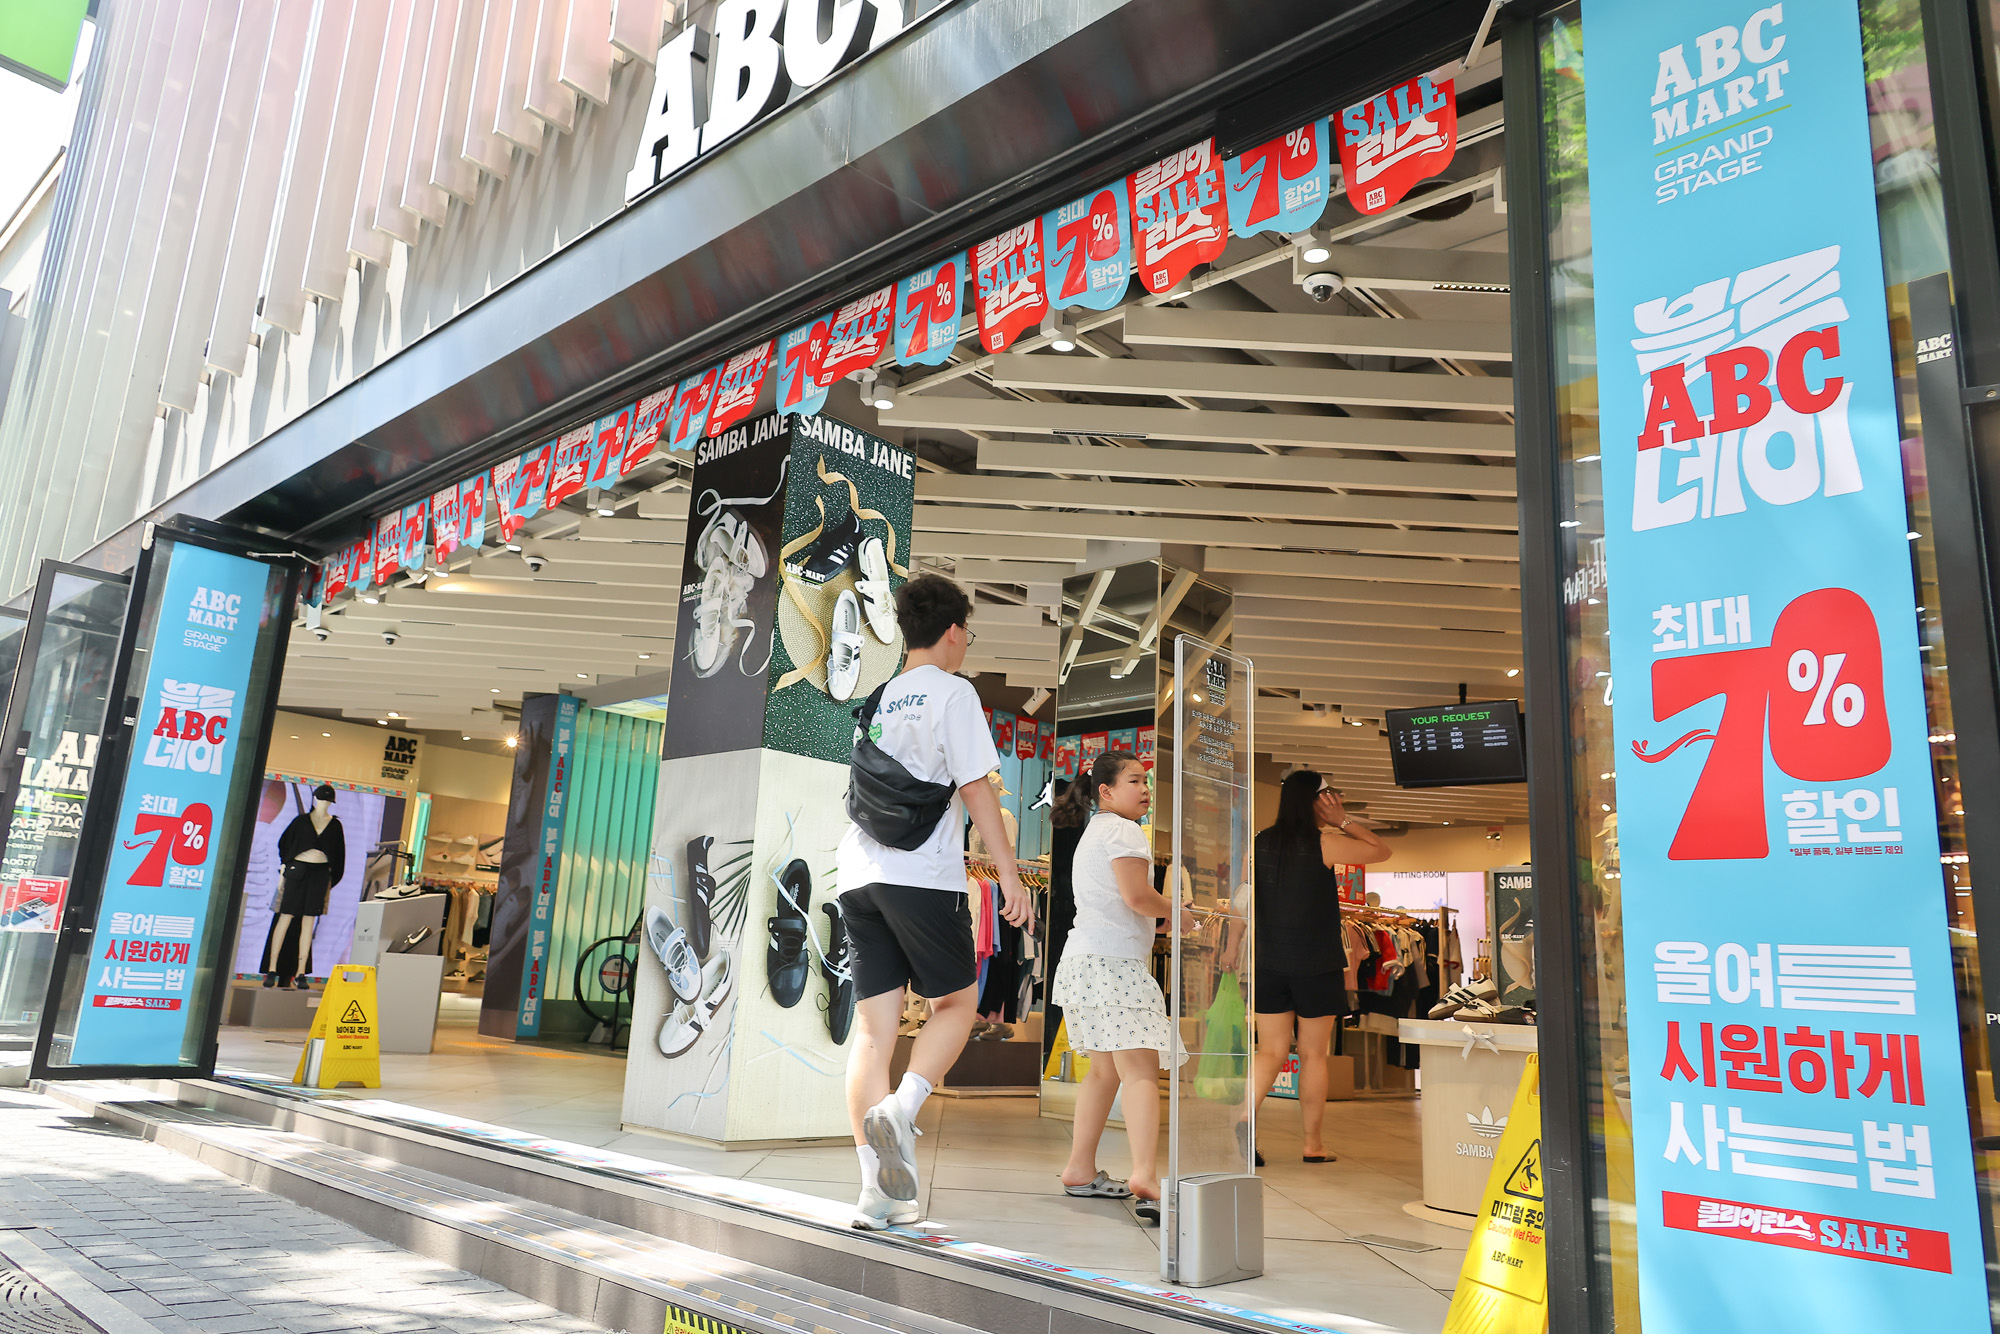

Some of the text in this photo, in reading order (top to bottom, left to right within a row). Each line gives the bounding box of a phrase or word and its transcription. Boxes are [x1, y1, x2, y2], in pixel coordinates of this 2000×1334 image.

[1650, 2, 1787, 107] ABC
[1342, 76, 1447, 147] SALE
[1652, 59, 1789, 146] MART
[1654, 125, 1774, 183] GRAND
[1654, 150, 1763, 205] STAGE
[1136, 169, 1220, 232] SALE
[1283, 177, 1321, 210] 할인
[1368, 191, 1383, 201] ABC
[1369, 198, 1384, 207] MART
[1057, 199, 1084, 226] 최대
[1051, 190, 1120, 300] 70%
[908, 269, 932, 292] 최대
[978, 242, 1042, 299] SALE
[1091, 261, 1123, 289] 할인
[1155, 272, 1166, 281] ABC
[900, 261, 956, 358] 70%
[787, 326, 806, 348] 최대
[827, 307, 891, 346] SALE
[931, 323, 955, 348] 할인
[992, 333, 1002, 343] ABC
[1917, 333, 1952, 354] ABC
[1917, 348, 1952, 364] MART
[683, 373, 702, 391] 최대
[717, 358, 767, 395] SALE
[1637, 325, 1845, 452] ABC
[632, 401, 670, 437] SALE
[688, 415, 704, 435] 할인
[698, 415, 789, 466] SAMBA JANE
[799, 413, 913, 481] SAMBA JANE
[554, 442, 591, 471] SALE
[496, 478, 513, 503] SAL
[434, 502, 459, 528] SALE
[378, 526, 400, 551] SALE
[785, 562, 826, 582] ABC-MART
[190, 586, 241, 616] ABC
[187, 607, 238, 631] MART
[1651, 594, 1752, 652] 최대
[183, 638, 222, 653] STAGE
[184, 629, 227, 645] GRAND
[887, 694, 927, 713] SKATE
[153, 707, 228, 745] ABC
[1411, 711, 1491, 725] YOUR REQUEST
[1630, 587, 1892, 861] 70%
[385, 735, 417, 753] ABC
[384, 750, 415, 764] MART
[139, 794, 178, 815] 최대
[1781, 787, 1903, 845] 할인
[124, 803, 213, 887] 70%
[1835, 847, 1853, 855] 일부
[1855, 846, 1882, 855] 브랜드
[1885, 845, 1903, 854] 제외
[169, 866, 205, 887] 할인
[1393, 870, 1446, 879] FITTING ROOM
[109, 912, 195, 938] 올여름
[104, 939, 190, 964] 시원하게
[97, 966, 185, 991] 사는 법
[1653, 941, 1917, 1016] 올여름
[145, 998, 171, 1009] SALE
[1282, 1059, 1299, 1073] BC
[1660, 1021, 1926, 1106] 시원하게
[1456, 1142, 1494, 1159] SAMBA
[1663, 1102, 1936, 1199] 사는 법
[1491, 1200, 1544, 1230] 미끄럼 주의
[1513, 1228, 1525, 1240] Wet
[1526, 1231, 1542, 1244] Floor
[1697, 1200, 1909, 1260] 클리어런스 SALE
[1491, 1250, 1523, 1268] ABC-MART
